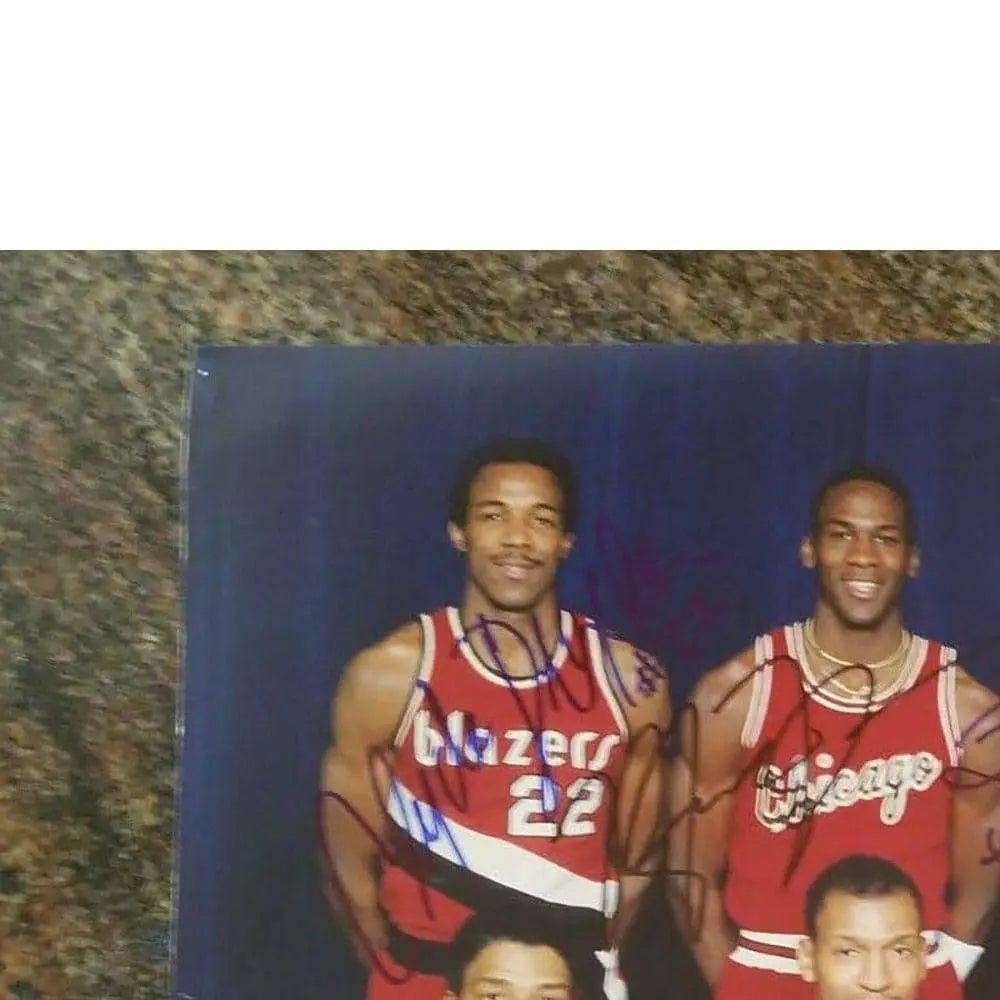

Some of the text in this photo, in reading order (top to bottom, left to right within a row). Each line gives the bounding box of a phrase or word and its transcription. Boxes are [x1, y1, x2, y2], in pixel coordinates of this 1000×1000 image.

[413, 709, 621, 772] blazers
[507, 773, 605, 837] 22
[755, 751, 943, 833] Chicago
